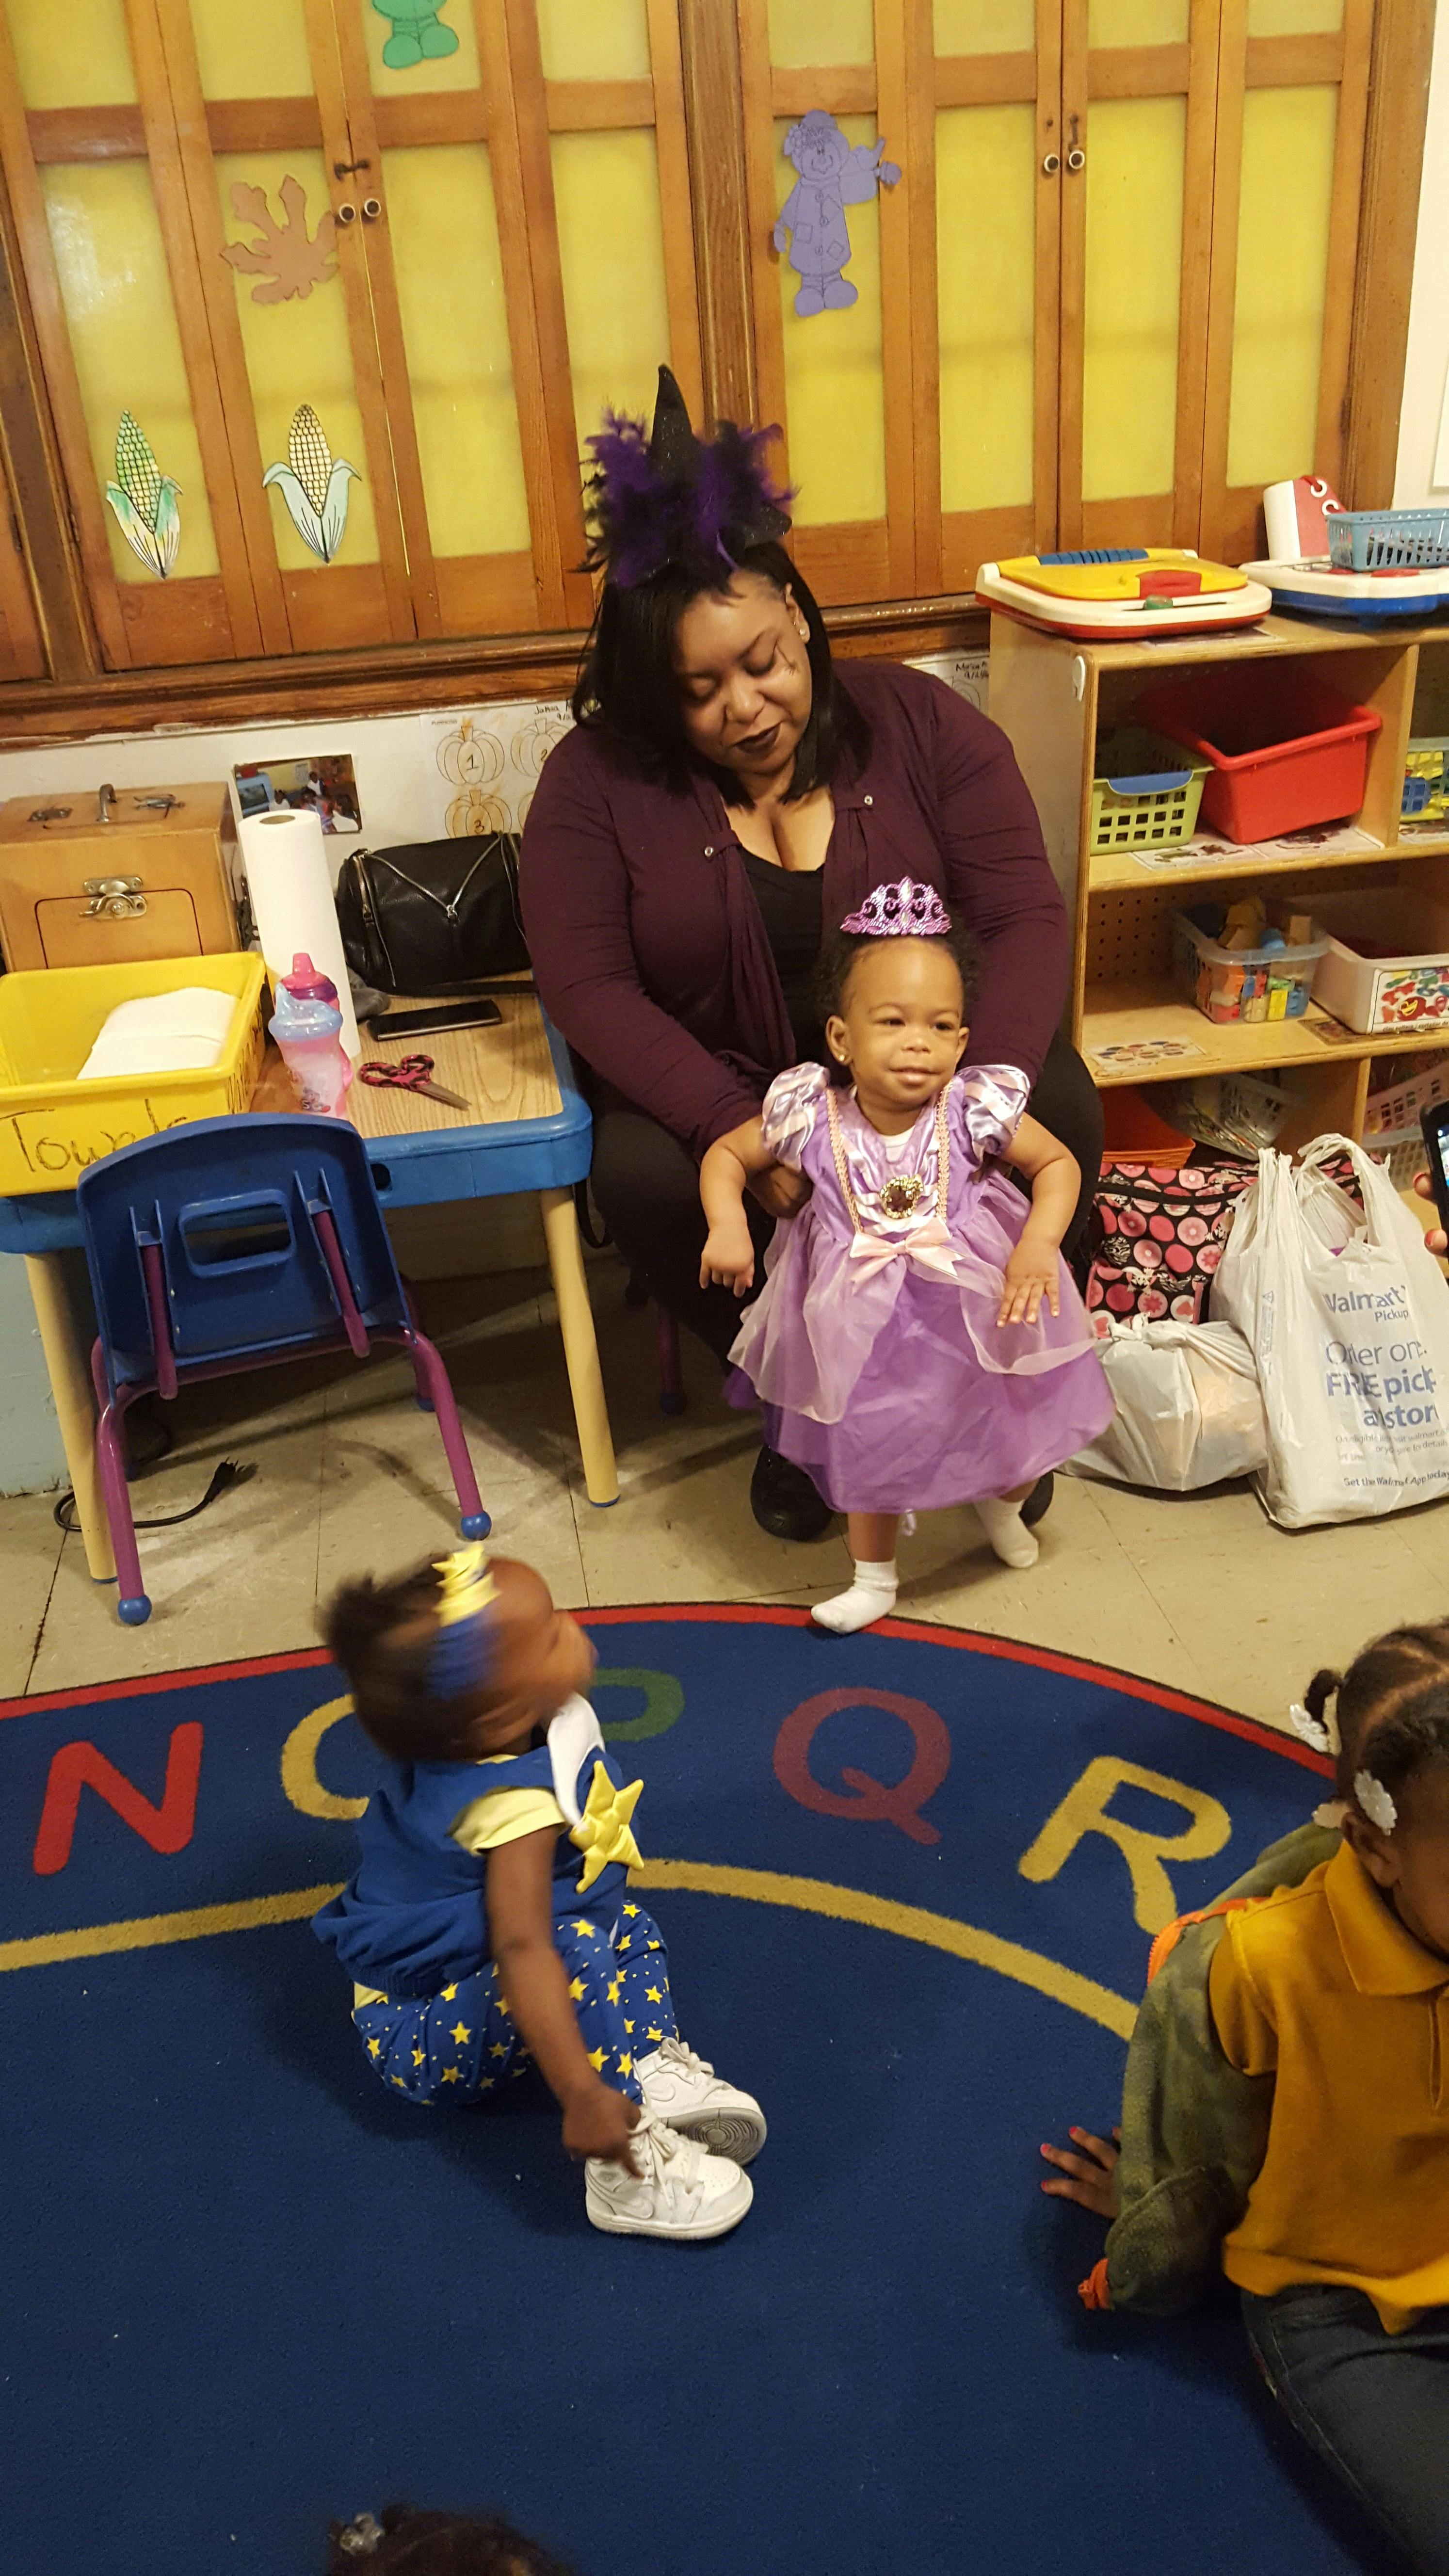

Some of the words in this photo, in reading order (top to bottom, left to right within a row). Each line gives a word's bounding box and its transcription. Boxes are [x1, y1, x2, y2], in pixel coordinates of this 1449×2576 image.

[466, 754, 480, 772] 1
[474, 820, 484, 834] 3
[1374, 1309, 1409, 1322] Pickup
[1344, 1476, 1360, 1486] Get
[33, 1722, 203, 1875] N
[773, 1686, 952, 1844] Q
[1017, 1755, 1232, 1938] R
